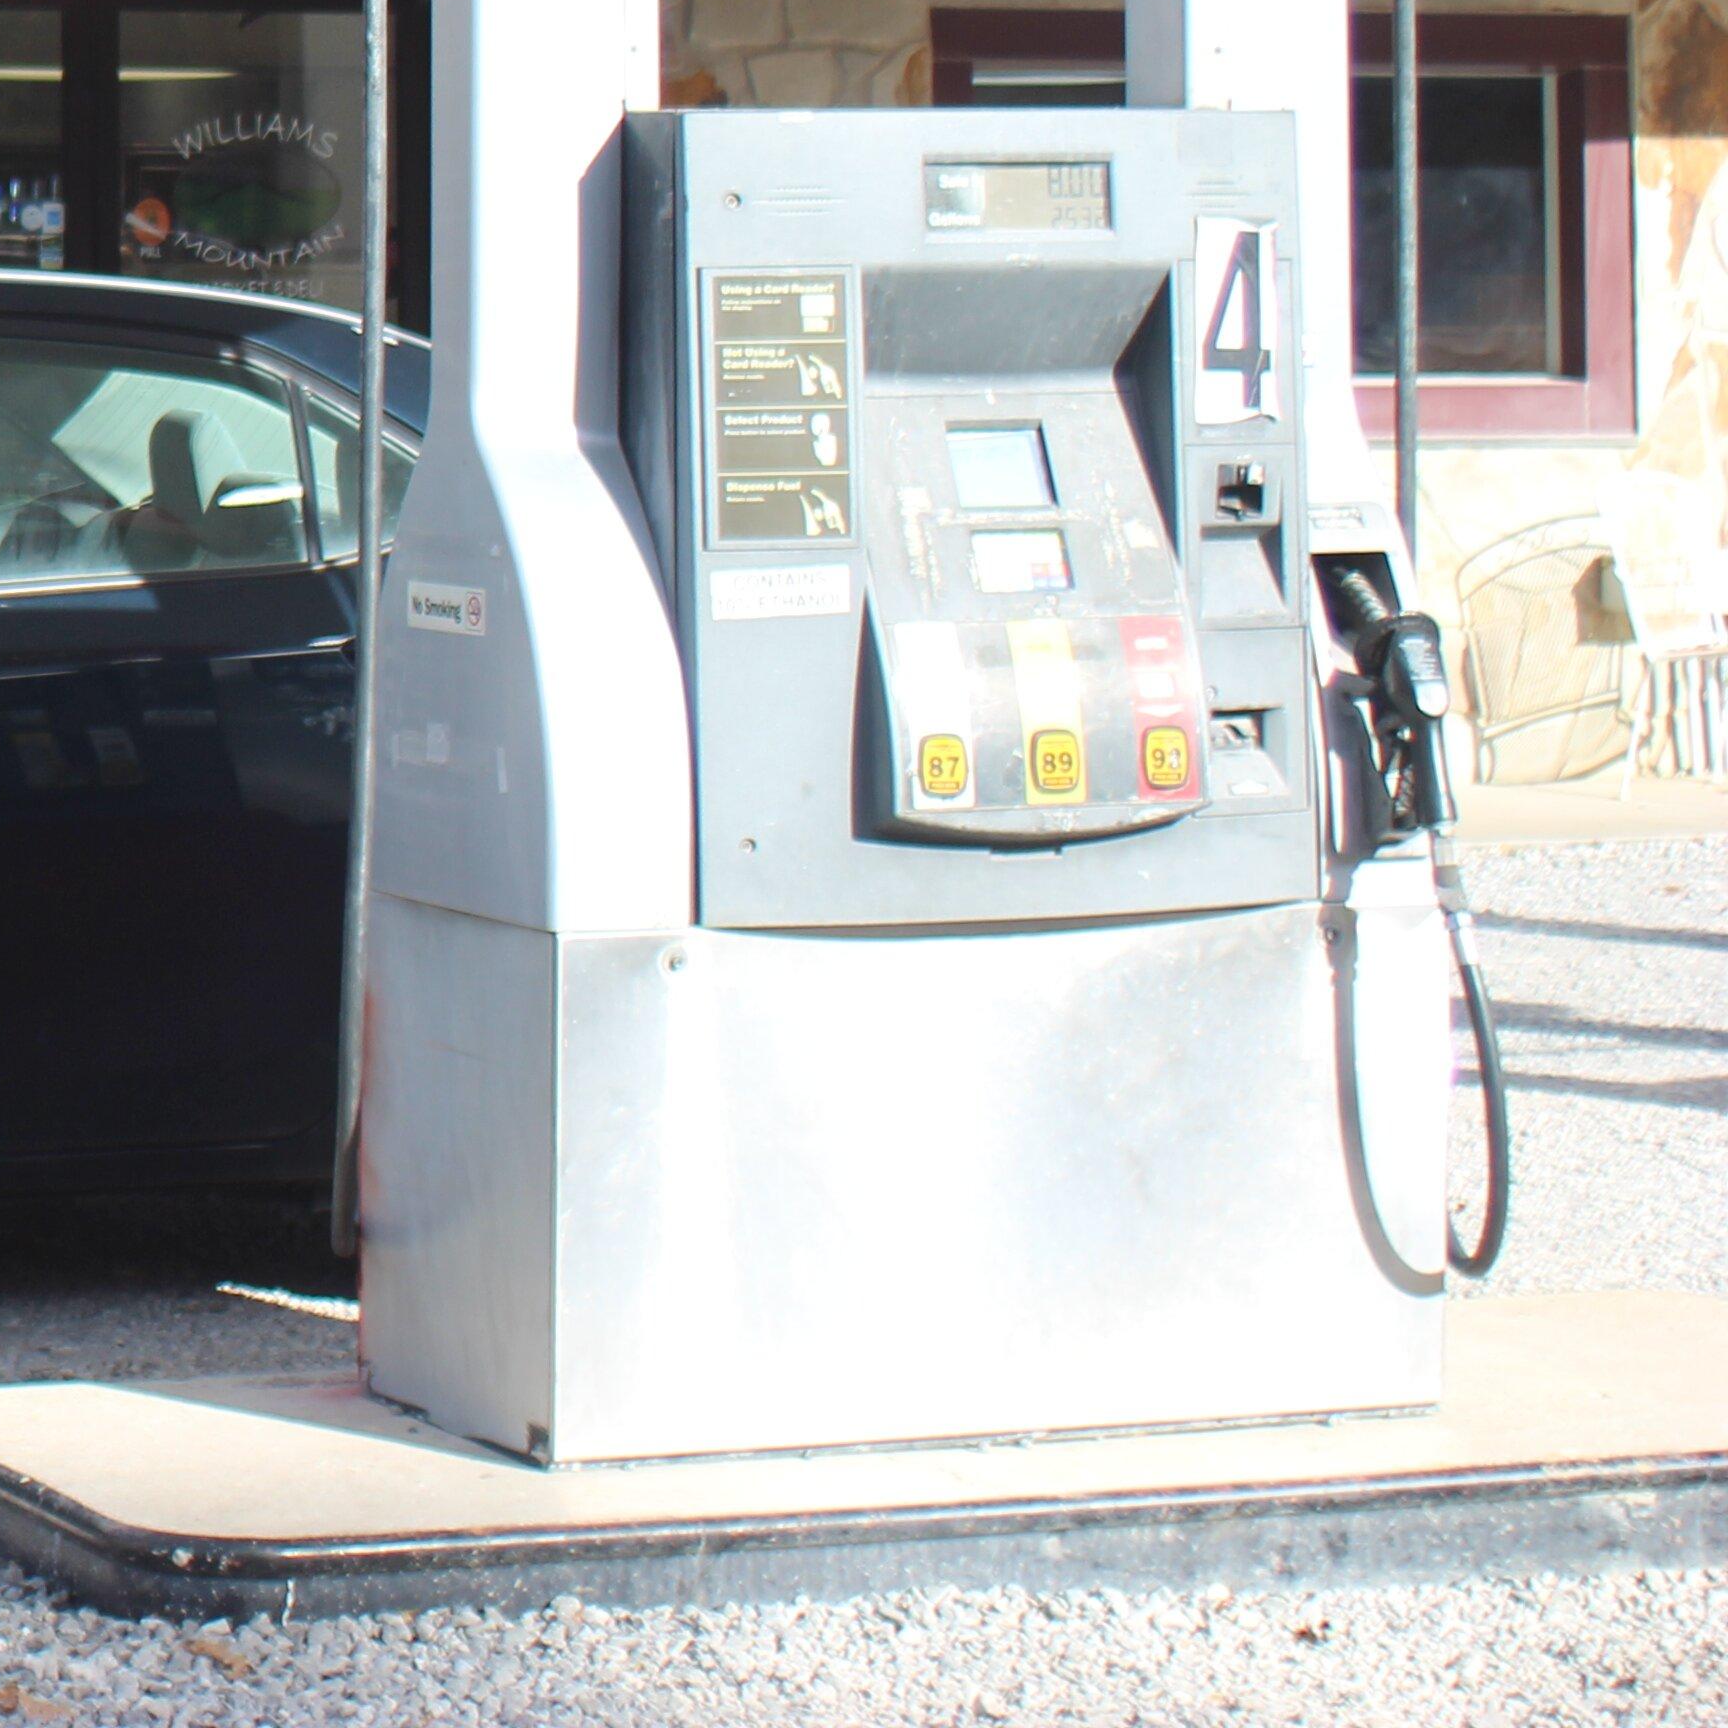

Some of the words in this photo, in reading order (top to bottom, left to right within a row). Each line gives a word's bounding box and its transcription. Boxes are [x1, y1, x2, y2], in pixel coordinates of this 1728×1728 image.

[171, 113, 338, 160] WILLIAMS
[174, 224, 345, 270] MOUNTAIN
[763, 283, 790, 294] Card
[1201, 230, 1271, 408] 4
[723, 359, 749, 369] Card
[724, 415, 759, 425] Select
[761, 414, 804, 424] Product
[412, 595, 423, 614] No
[425, 597, 461, 624] Smoking
[928, 756, 959, 777] 87
[1042, 752, 1073, 774] 89
